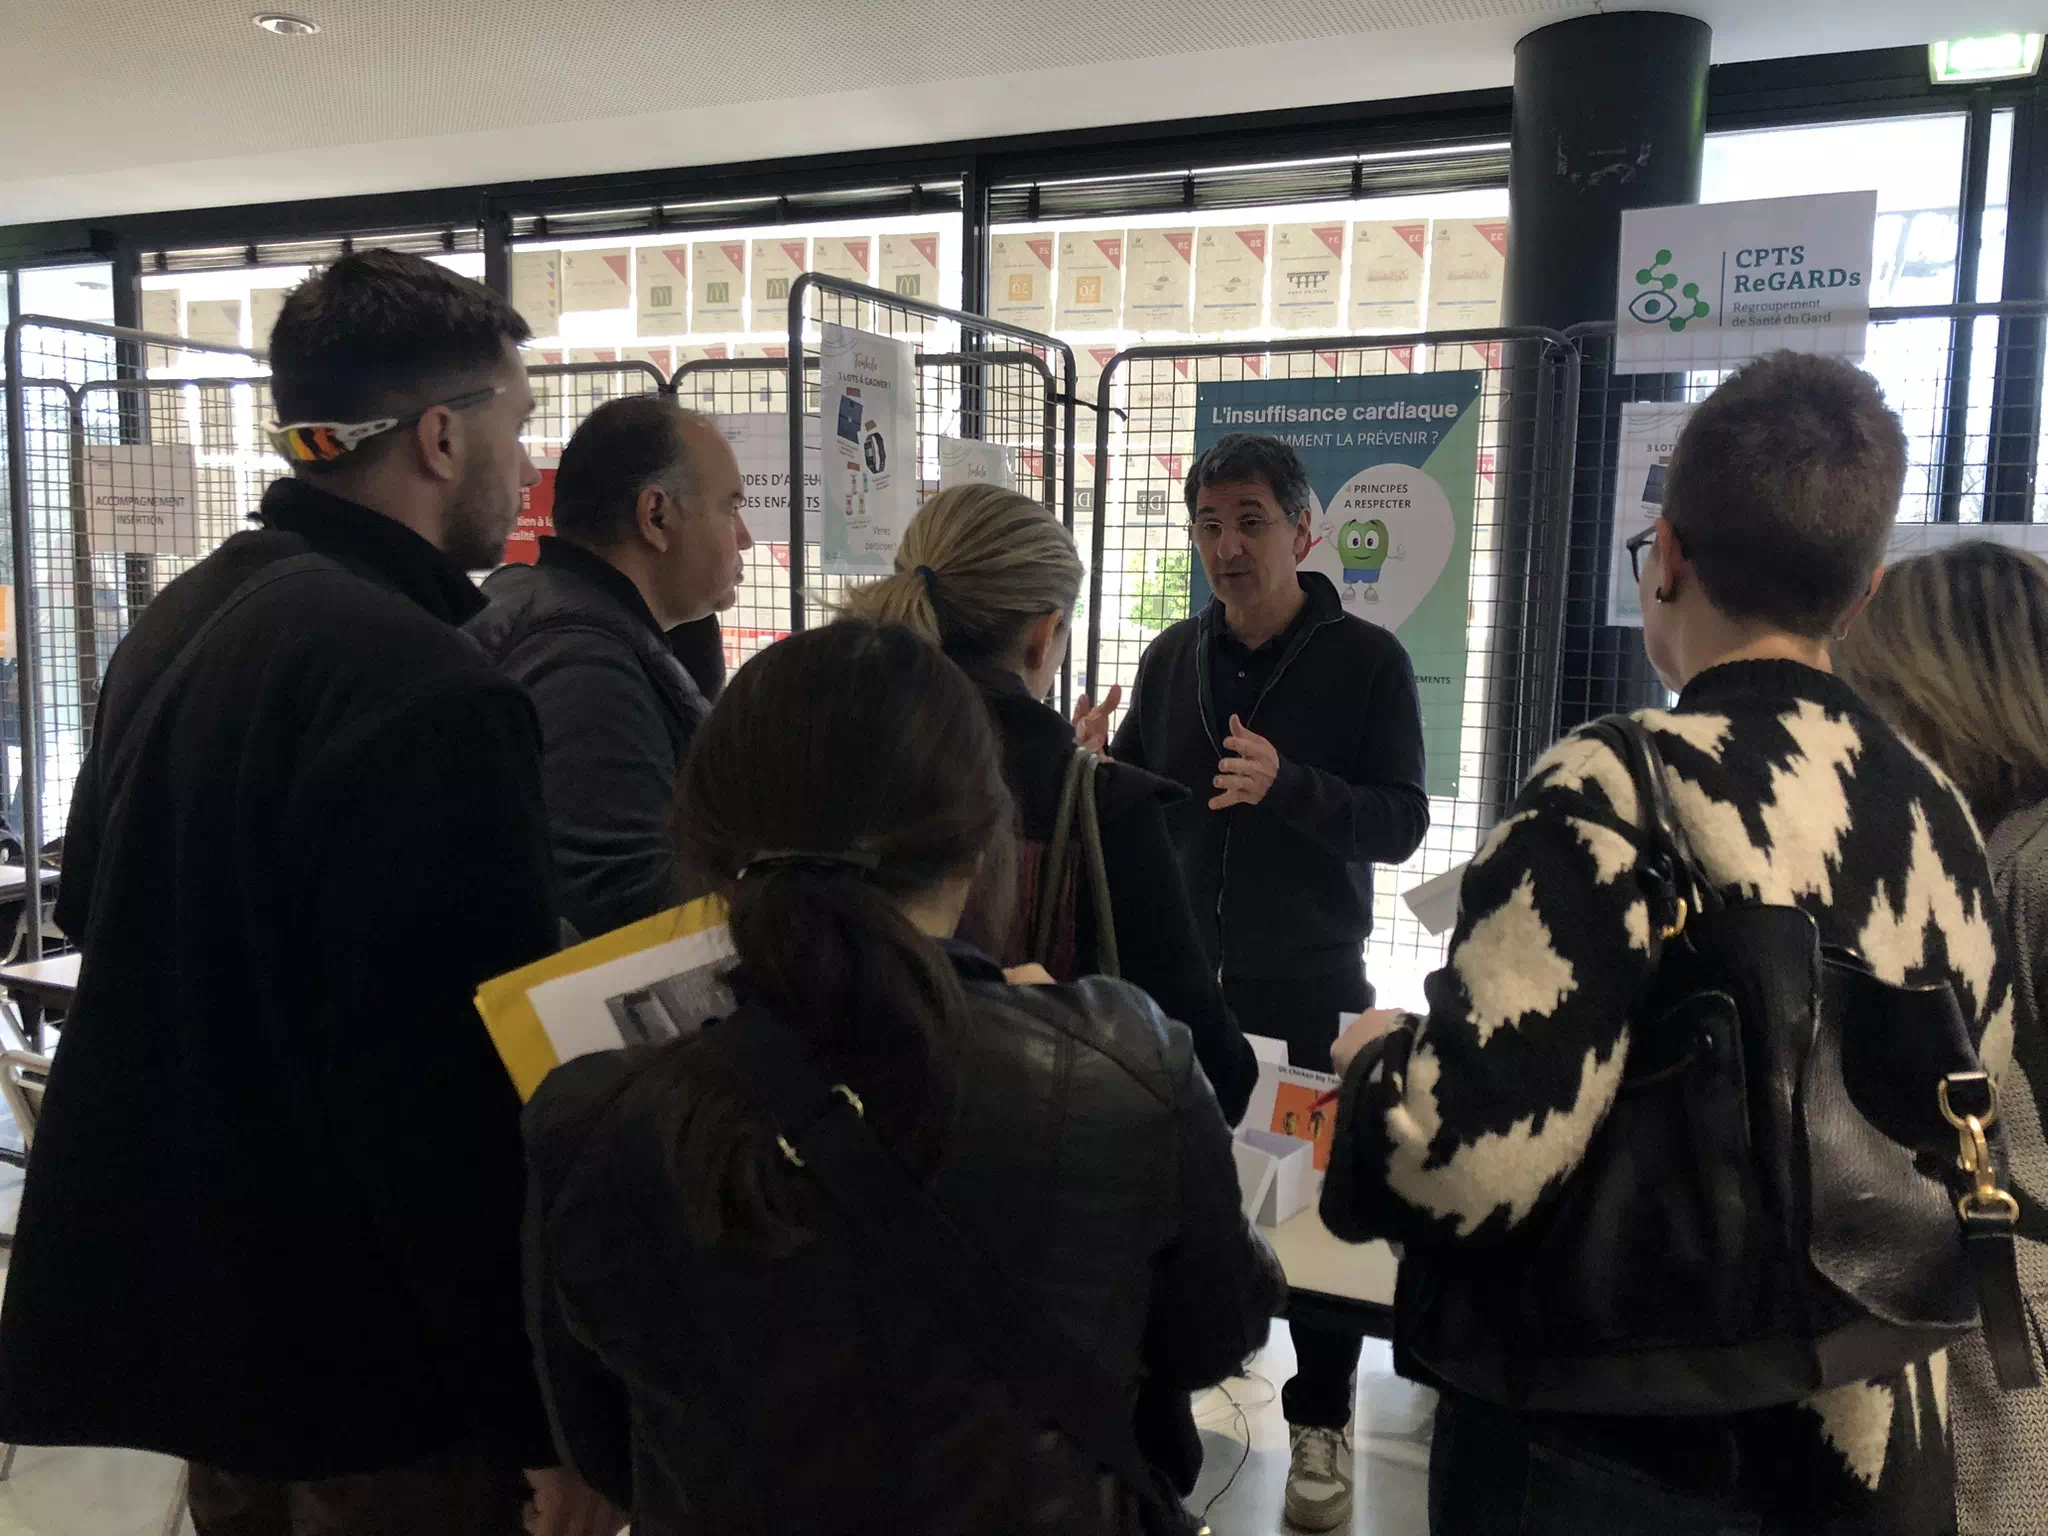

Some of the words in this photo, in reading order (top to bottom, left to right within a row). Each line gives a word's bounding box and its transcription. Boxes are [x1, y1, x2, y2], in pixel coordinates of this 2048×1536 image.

[1735, 246, 1805, 269] CPTS
[1734, 268, 1861, 293] ReGARDs
[1733, 299, 1820, 314] Regroupement
[1731, 316, 1746, 327] de
[1747, 313, 1781, 326] Santé
[1783, 313, 1798, 324] du
[1801, 312, 1832, 324] Gard
[843, 374, 859, 384] LOTS
[865, 377, 888, 389] GAGNER
[1212, 404, 1347, 424] L'insuffisance
[1352, 401, 1459, 422] cardiaque
[1272, 434, 1333, 447] MMENT
[1336, 434, 1353, 446] LA
[1357, 430, 1427, 446] PRÉVENIR
[1431, 430, 1439, 444] ?
[1646, 444, 1652, 453] 3
[1655, 444, 1673, 453] LOT
[740, 474, 768, 486] DES
[1354, 484, 1408, 494] PRINCIPES
[95, 496, 185, 508] ACCOMPAGNEMENT
[764, 496, 820, 508] ENFTS
[1344, 500, 1352, 508] A
[1354, 499, 1411, 509] RESPECTER
[116, 514, 164, 526] INSERTION
[872, 527, 891, 536] Venez
[1414, 675, 1451, 684] EMENTS
